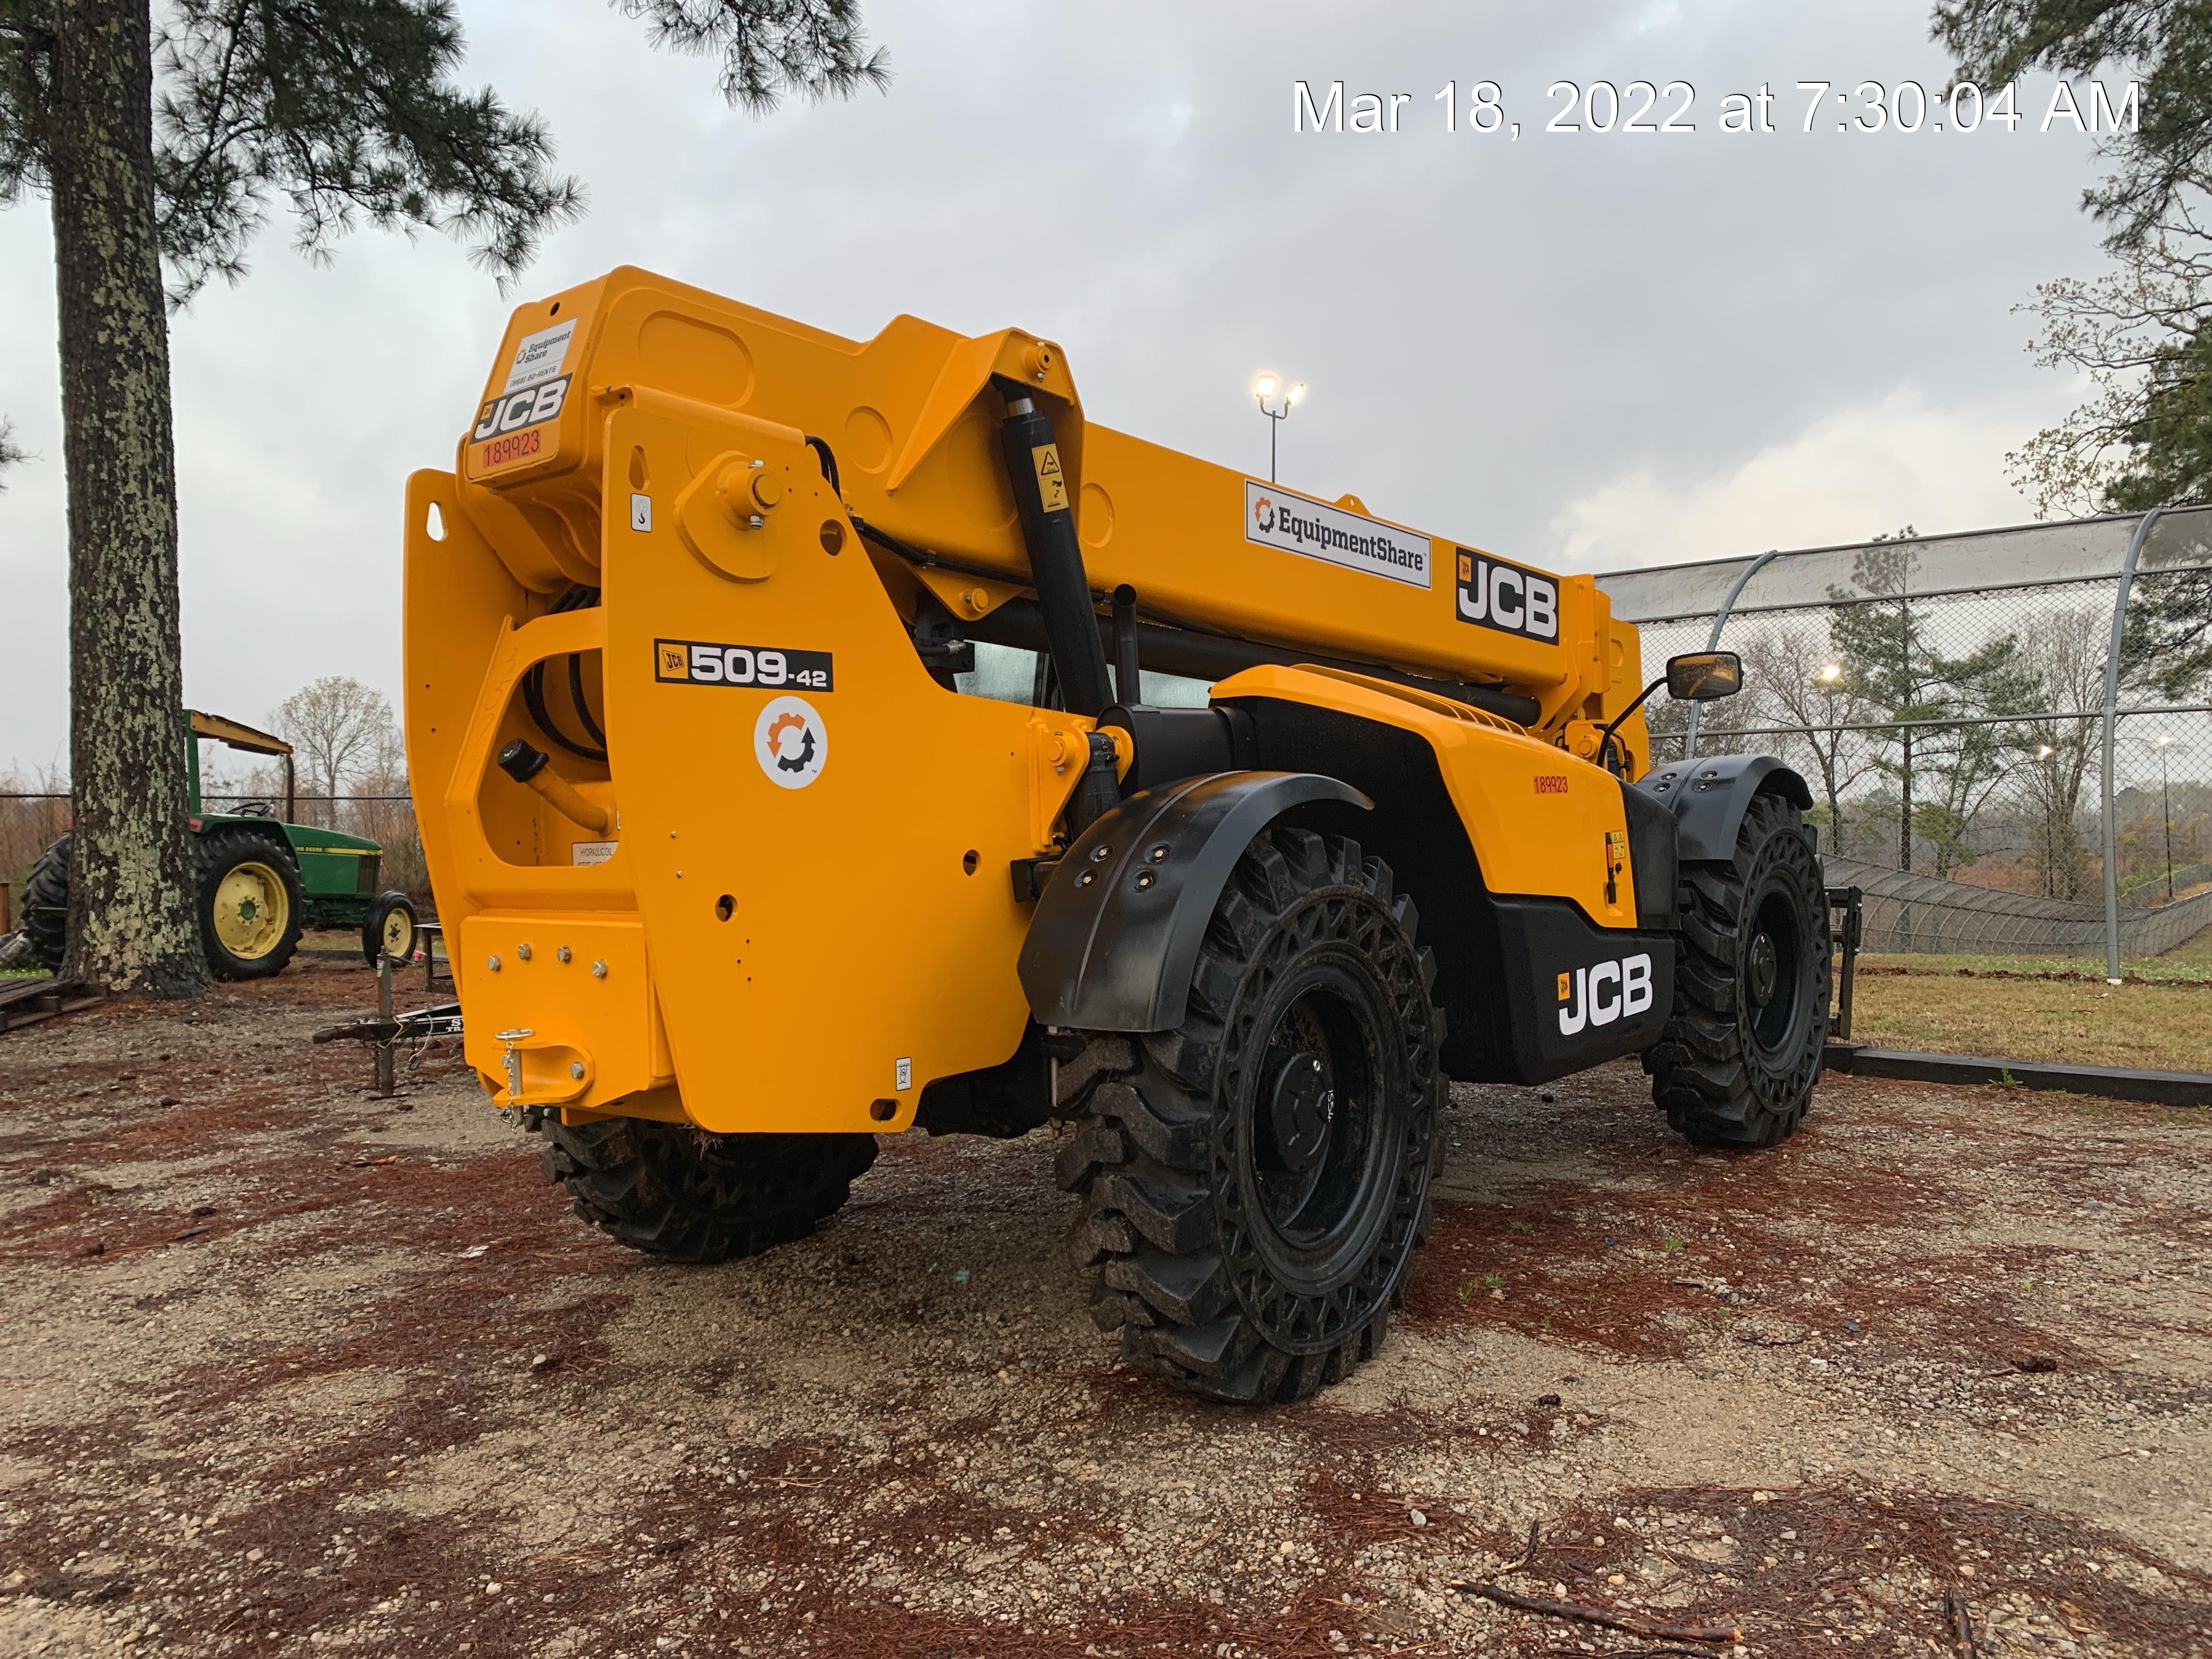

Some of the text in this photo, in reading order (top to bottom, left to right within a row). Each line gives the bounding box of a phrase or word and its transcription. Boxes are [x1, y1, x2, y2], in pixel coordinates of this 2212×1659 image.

[524, 350, 547, 363] Share
[528, 331, 571, 353] Equipment
[527, 366, 556, 381] 80-RENTS
[474, 379, 567, 439] JCB
[485, 430, 539, 466] 189923
[1279, 506, 1423, 571] EquipmentShare
[1459, 560, 1557, 637] JCB
[665, 646, 827, 687] JCB 509-42
[1534, 776, 1568, 793] 189923
[580, 848, 604, 856] HYDRAULIC
[1559, 953, 1653, 1035] JCB
